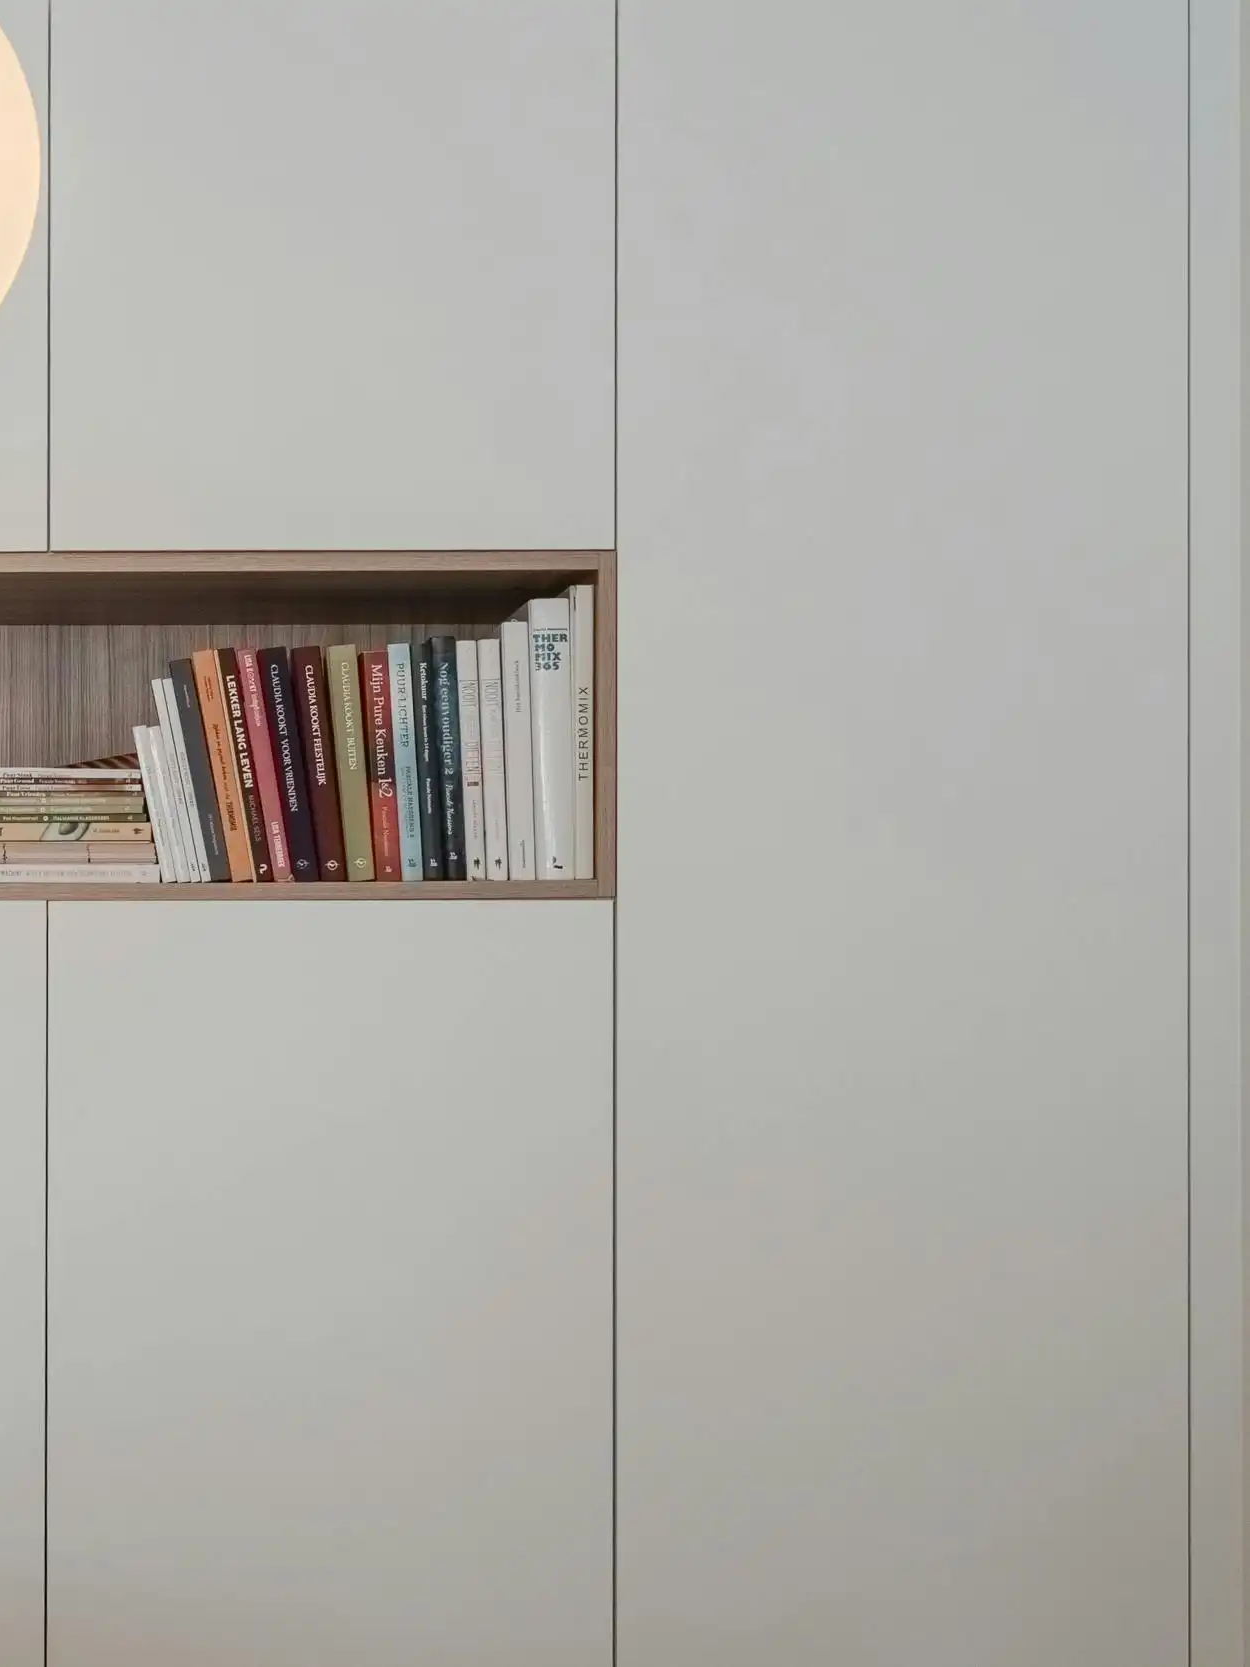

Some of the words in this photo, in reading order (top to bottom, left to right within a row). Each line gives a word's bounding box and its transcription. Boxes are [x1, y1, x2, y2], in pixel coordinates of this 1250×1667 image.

[533, 633, 568, 643] THER
[535, 643, 555, 652] MO
[535, 652, 561, 661] MIX
[535, 661, 560, 671] 365
[270, 664, 282, 704] CLAUDIA
[305, 665, 316, 704] CLAUDIA
[341, 662, 351, 701] CLAUDIA
[369, 664, 383, 693] Mijn
[397, 663, 405, 693] PUUR
[420, 662, 428, 700] Ketokuur
[438, 662, 449, 686] Nog
[374, 696, 385, 725] Pure
[462, 682, 476, 708] NOOIT
[226, 675, 240, 717] LEKKER
[234, 720, 246, 750] LANG
[240, 752, 252, 788] LEVEN
[276, 704, 287, 737] KOOKT
[310, 705, 320, 738] KOOKT
[345, 702, 354, 733] KOOKT
[399, 697, 408, 748] LICHTER
[439, 689, 453, 765] eenvoudiger
[578, 686, 589, 782] THERMOMIX
[281, 739, 291, 766] VOOR
[312, 738, 326, 786] FEESTELIJK
[348, 737, 356, 770] BUITEN
[375, 728, 388, 775] Keuken
[378, 777, 392, 798] 1&2
[445, 767, 453, 775] 2
[285, 766, 298, 813] VRIENDEN
